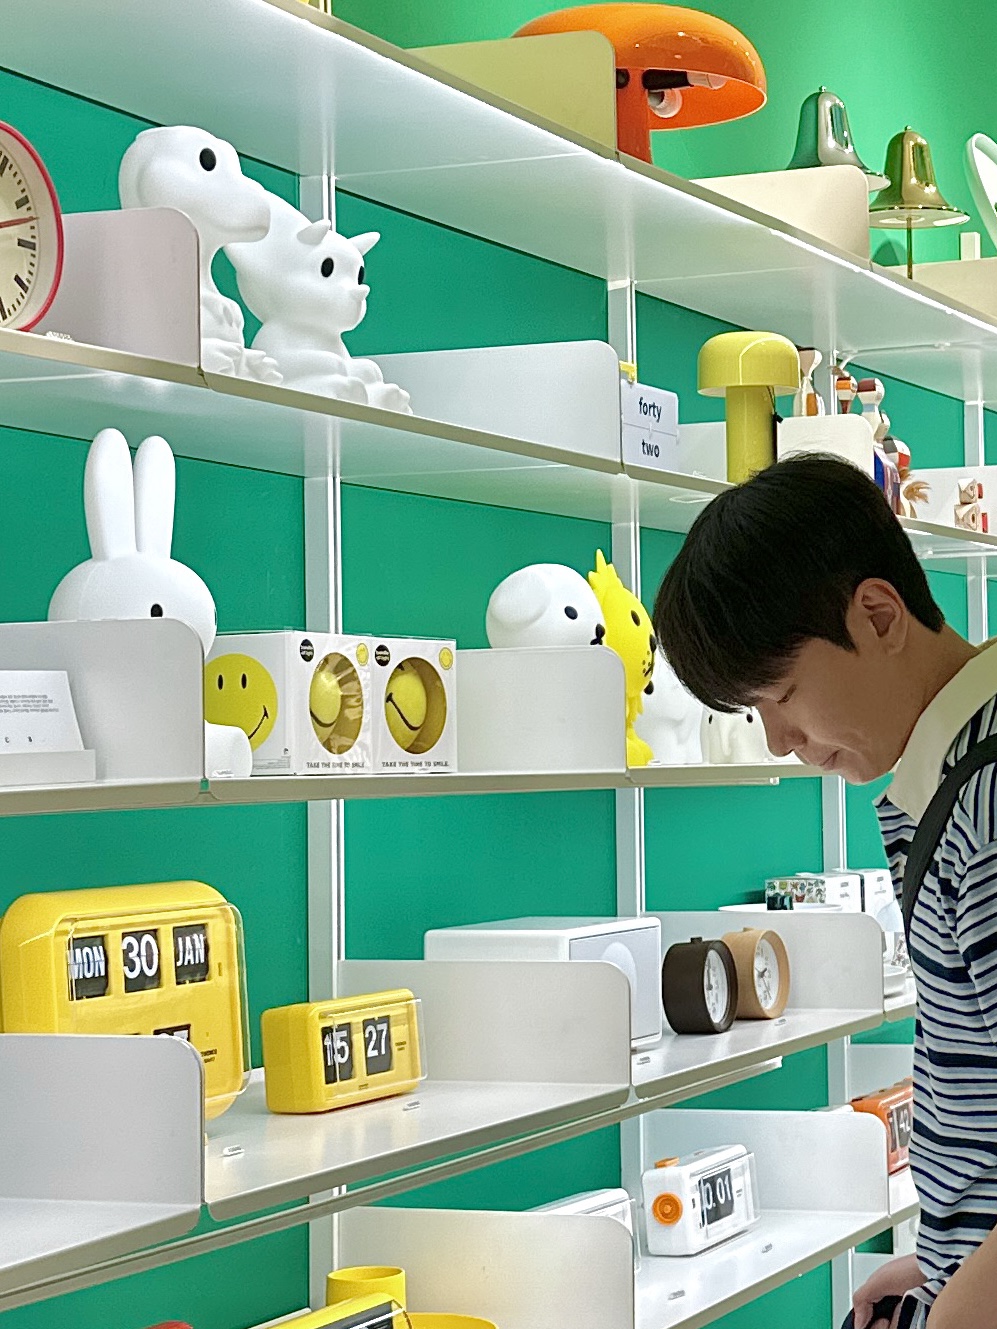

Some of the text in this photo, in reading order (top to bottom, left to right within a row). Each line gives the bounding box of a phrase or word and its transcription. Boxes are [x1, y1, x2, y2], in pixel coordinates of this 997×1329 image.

[638, 397, 662, 423] forty
[641, 439, 660, 458] two
[68, 933, 206, 980] MON 30 JAN
[323, 1023, 388, 1067] 15 27
